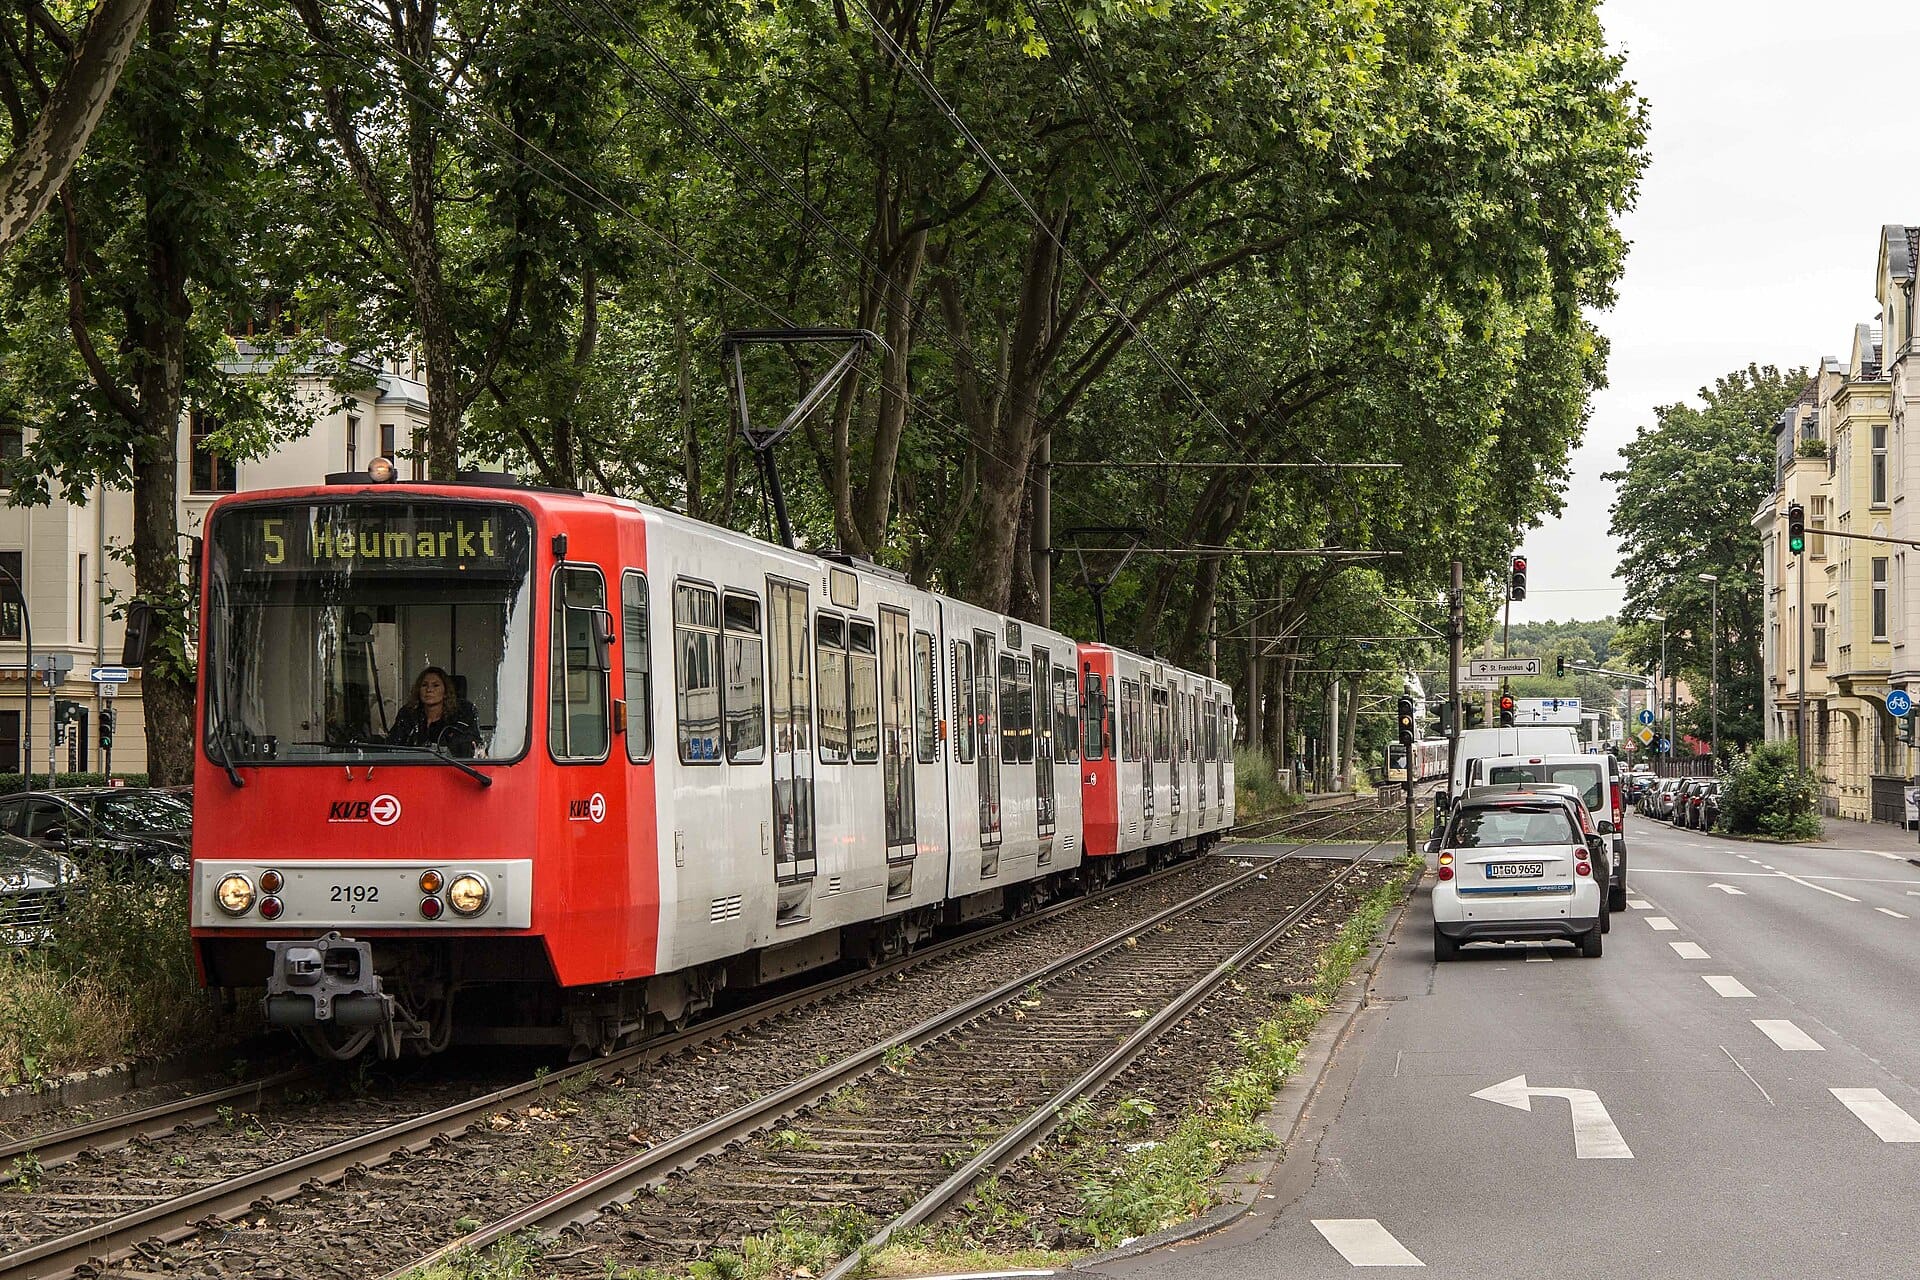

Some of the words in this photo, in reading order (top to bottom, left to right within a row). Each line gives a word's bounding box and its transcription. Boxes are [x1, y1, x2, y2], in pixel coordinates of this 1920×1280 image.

[263, 519, 285, 564] 5
[312, 520, 494, 558] Heumarkt
[330, 802, 370, 818] KVB
[570, 800, 590, 816] KVB
[1493, 867, 1499, 875] D
[1519, 864, 1542, 874] 9652
[330, 885, 379, 902] 2192
[351, 905, 356, 913] 2
